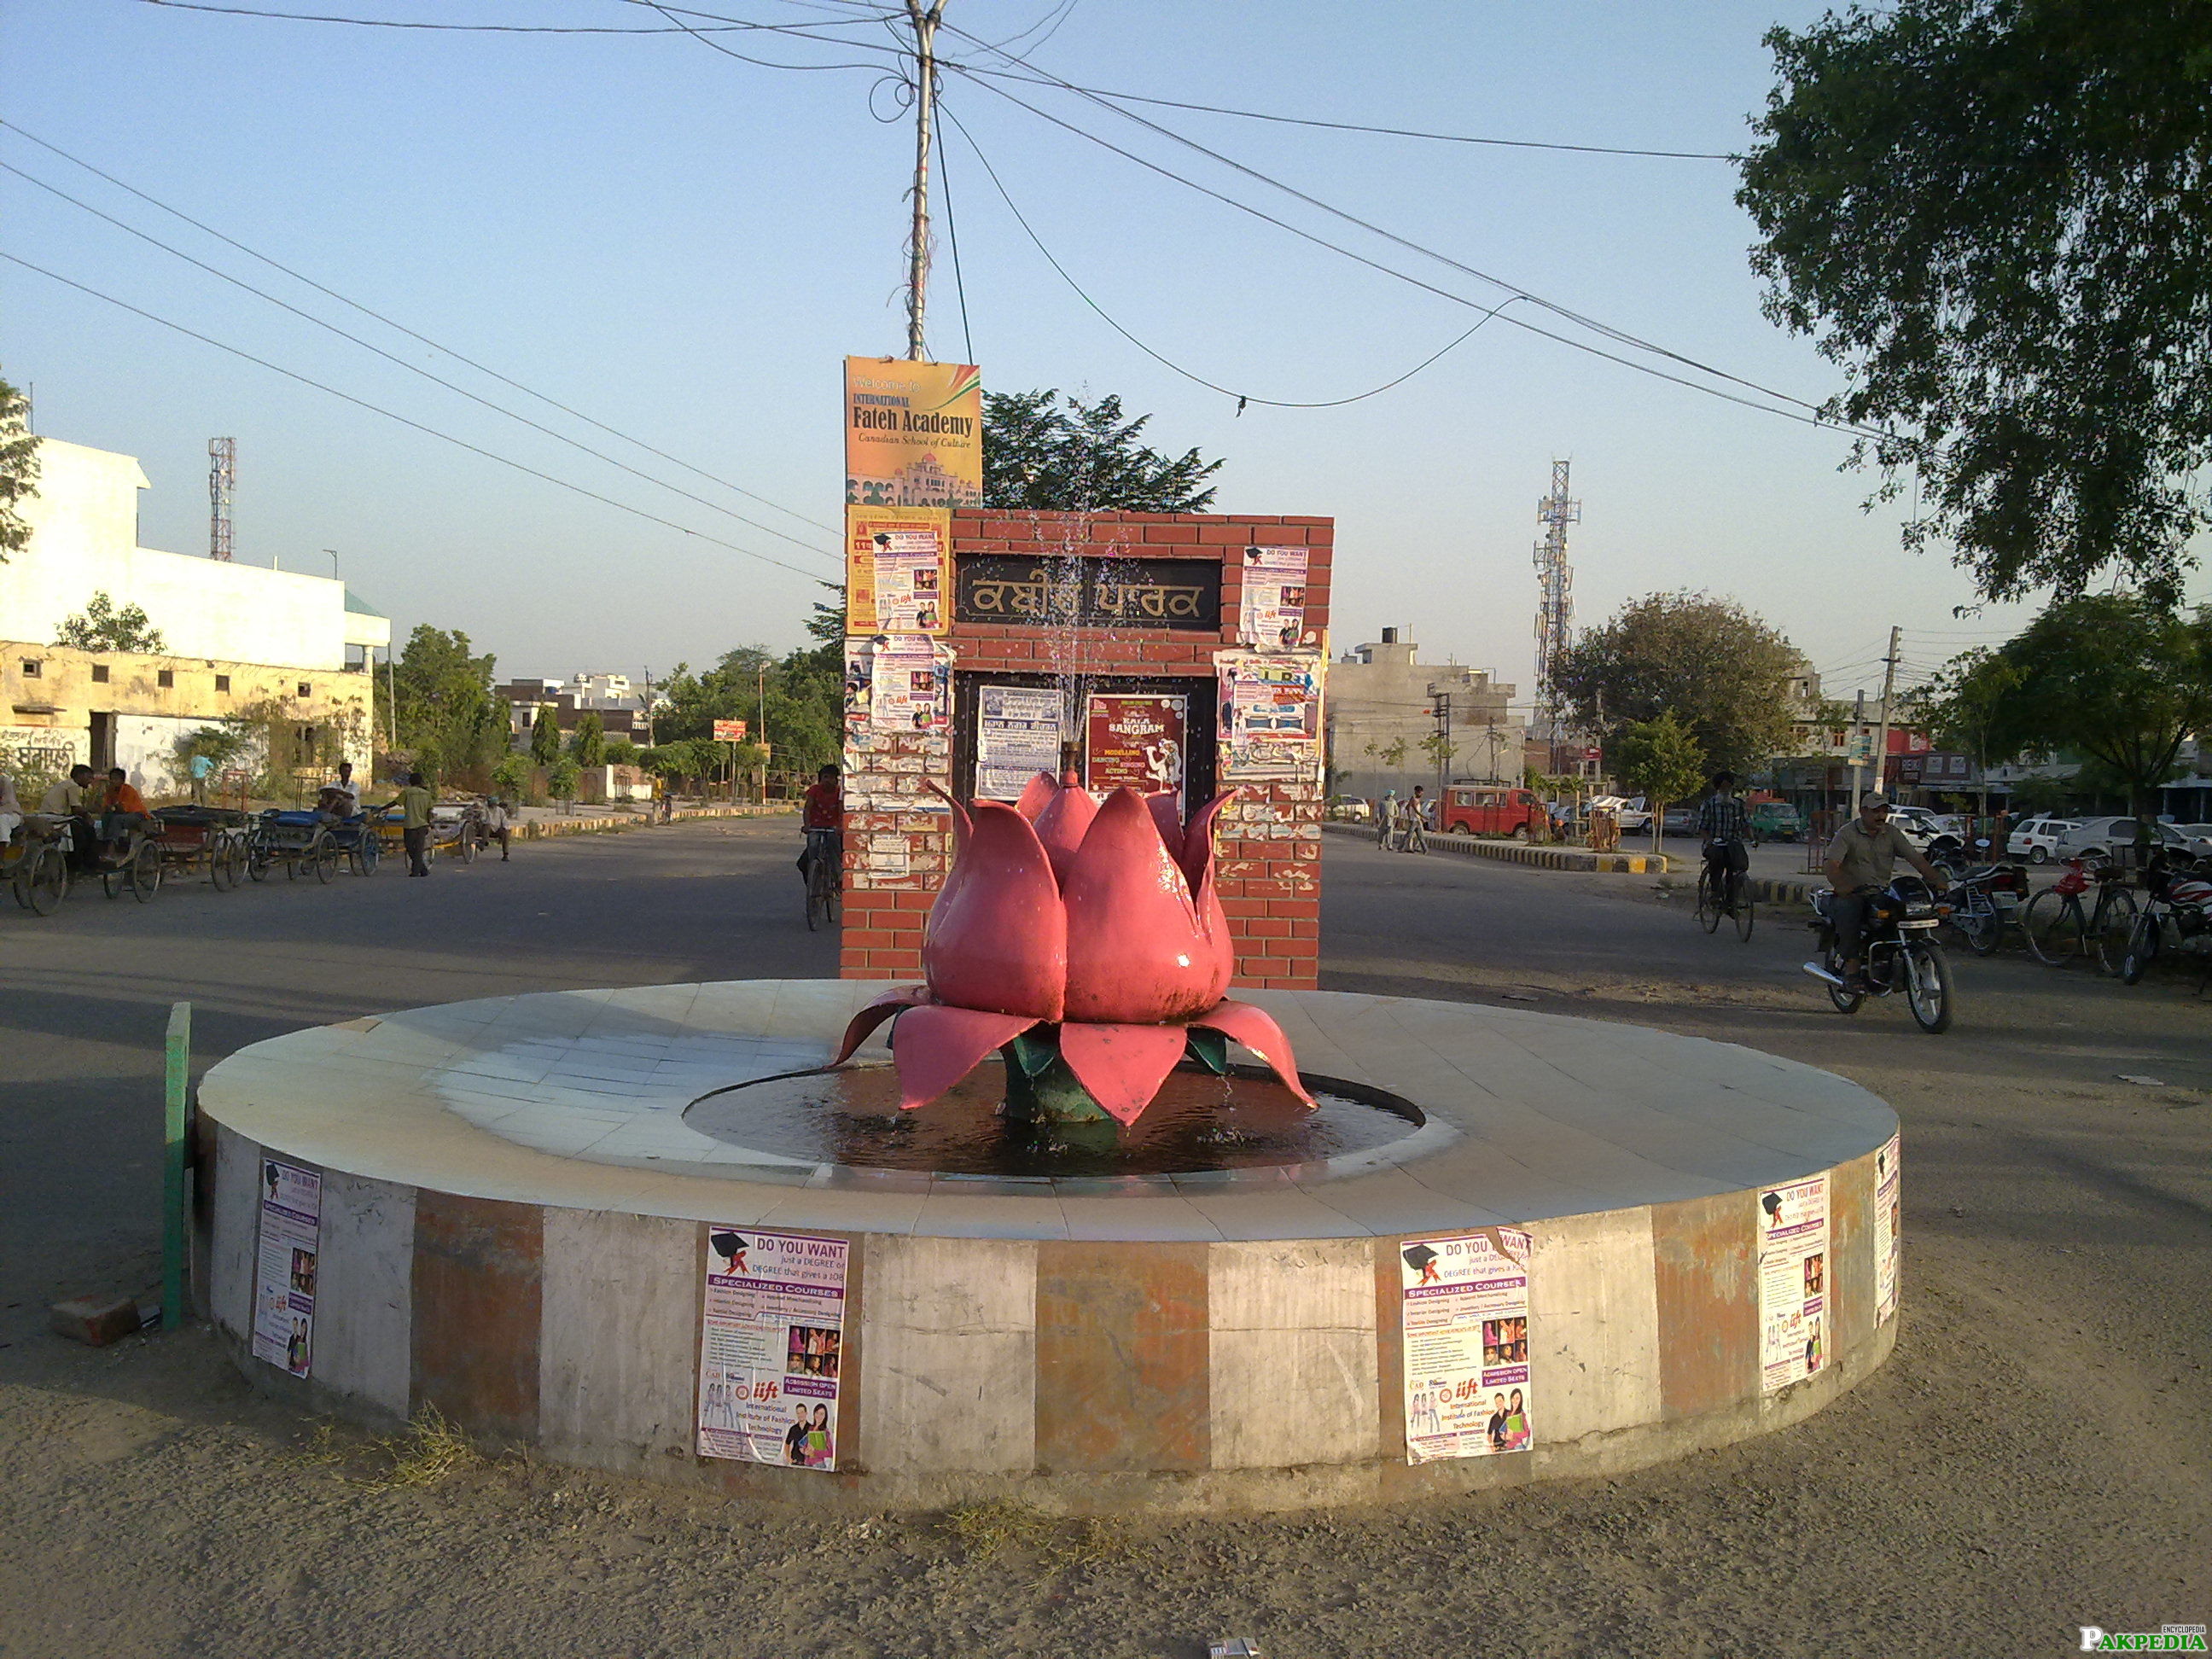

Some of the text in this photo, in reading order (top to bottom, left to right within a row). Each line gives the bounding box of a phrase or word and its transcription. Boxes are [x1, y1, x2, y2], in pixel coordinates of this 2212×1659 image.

[853, 375, 921, 393] Welcome to
[853, 393, 910, 408] INTERNATIONAL
[854, 406, 974, 438] Fateh Academy
[859, 433, 971, 449] Canadian School of Culture
[1109, 724, 1165, 735] SANGRAM
[757, 1237, 845, 1258] DO YOU WANT
[1446, 1244, 1462, 1256] DO
[1464, 1241, 1487, 1254] YOU
[804, 1257, 835, 1268] DEGREE
[753, 1265, 782, 1275] DEGREE
[784, 1267, 800, 1277] that
[1444, 1267, 1470, 1278] DEGREE
[713, 1277, 840, 1298] SPECIALIZED COURSES
[1408, 1284, 1474, 1298] SPECIALIZED
[754, 1380, 779, 1402] iift
[818, 1381, 837, 1389] OPEN
[1456, 1378, 1479, 1400] iift
[746, 1402, 788, 1413] International
[1450, 1400, 1487, 1410] International
[771, 1415, 797, 1424] Fashion
[1453, 1420, 1485, 1430] Technology
[748, 1423, 783, 1435] Technology
